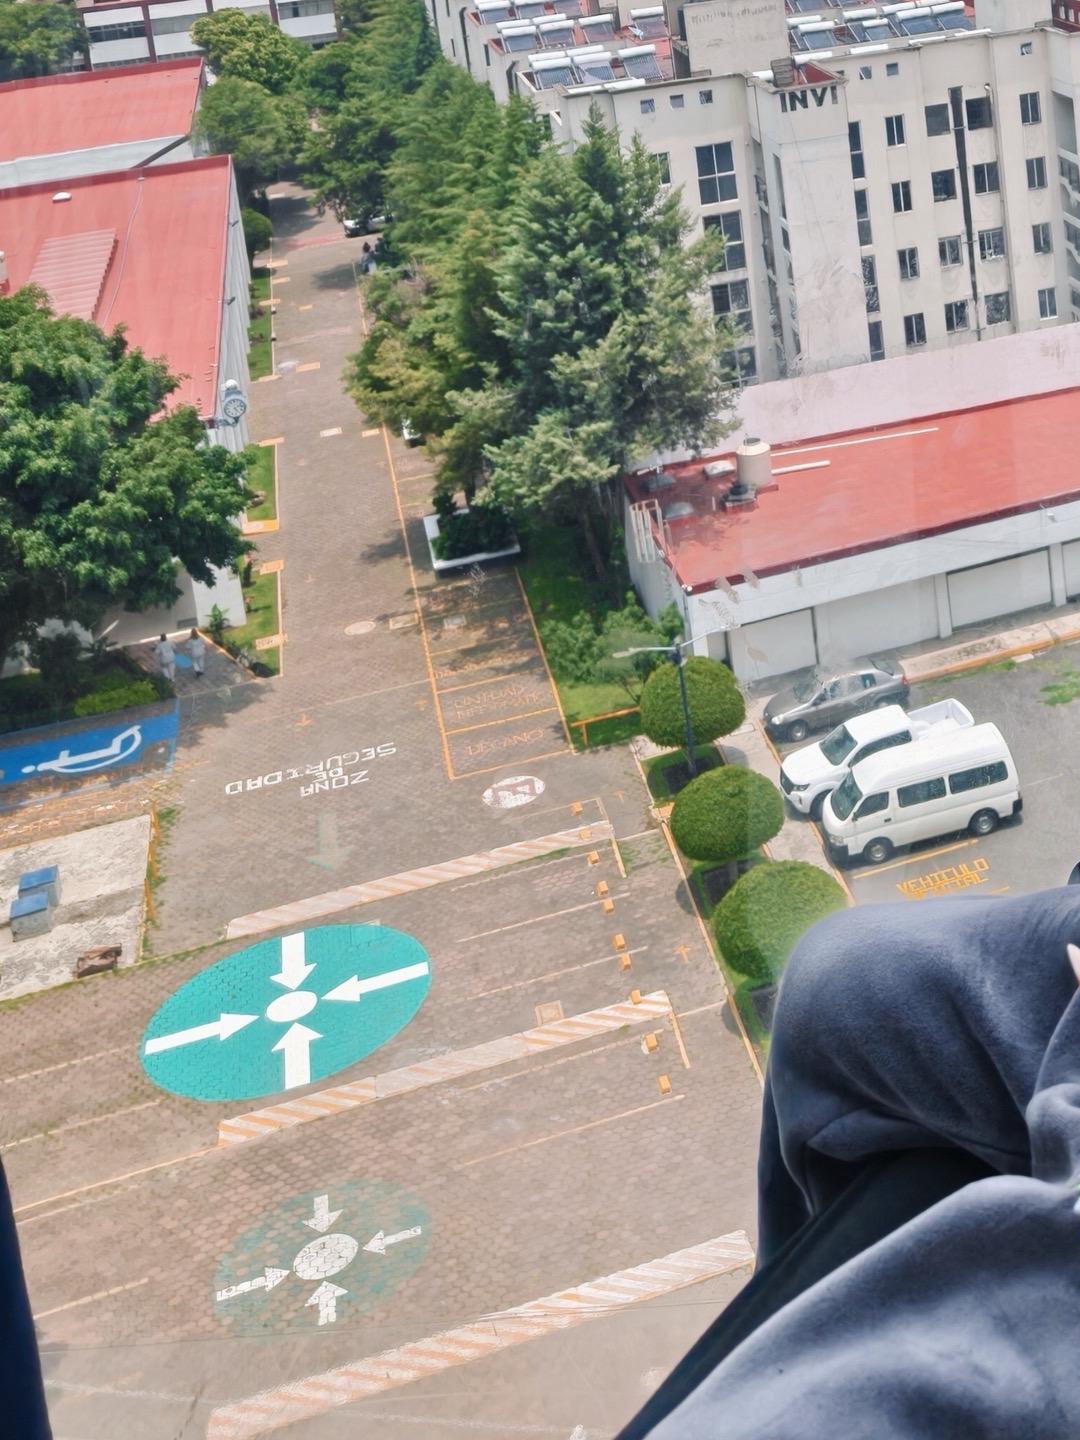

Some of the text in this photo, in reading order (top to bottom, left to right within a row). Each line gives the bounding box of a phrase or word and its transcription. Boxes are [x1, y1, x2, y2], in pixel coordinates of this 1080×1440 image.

[779, 85, 838, 112] INVI
[225, 742, 397, 795] SEGURIDAD
[312, 767, 343, 783] DE
[300, 770, 370, 798] ZONA
[896, 858, 989, 894] VEHICULO
